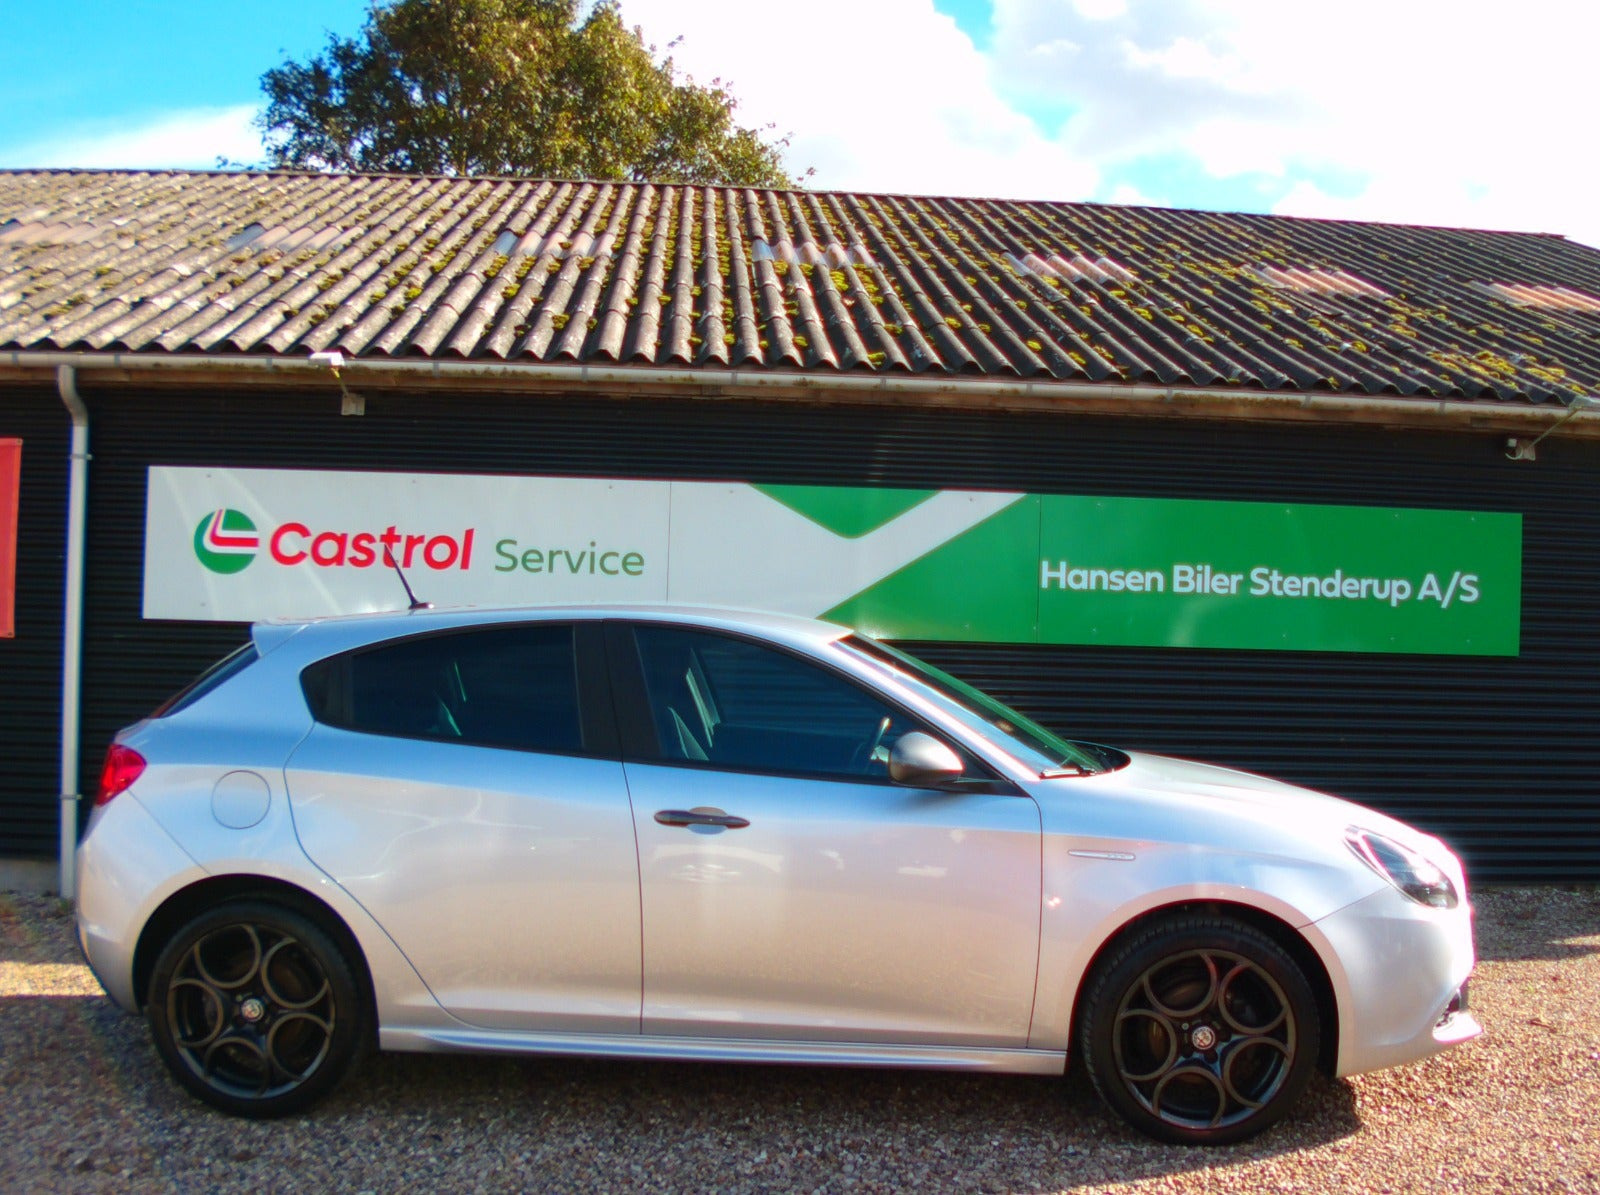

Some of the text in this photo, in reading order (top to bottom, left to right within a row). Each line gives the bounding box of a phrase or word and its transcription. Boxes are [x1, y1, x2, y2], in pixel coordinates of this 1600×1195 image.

[270, 523, 645, 576] Castrol Service
[1040, 560, 1480, 608] Hansen Biler Stenderup A/S
